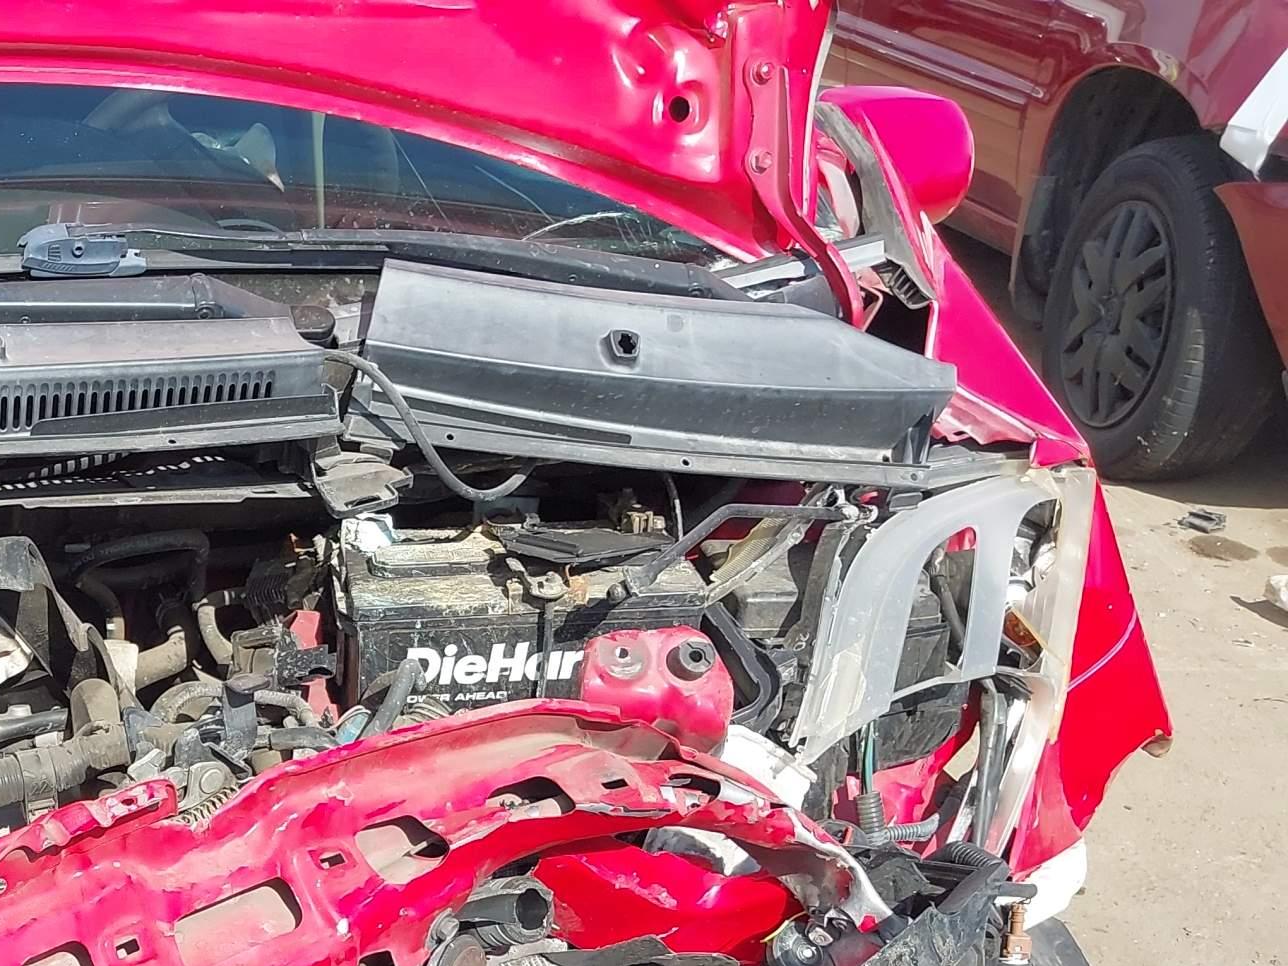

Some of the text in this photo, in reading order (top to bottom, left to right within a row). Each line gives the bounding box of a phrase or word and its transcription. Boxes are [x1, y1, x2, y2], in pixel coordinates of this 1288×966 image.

[407, 641, 585, 686] DieHar
[406, 691, 508, 704] OWR AHEAD
